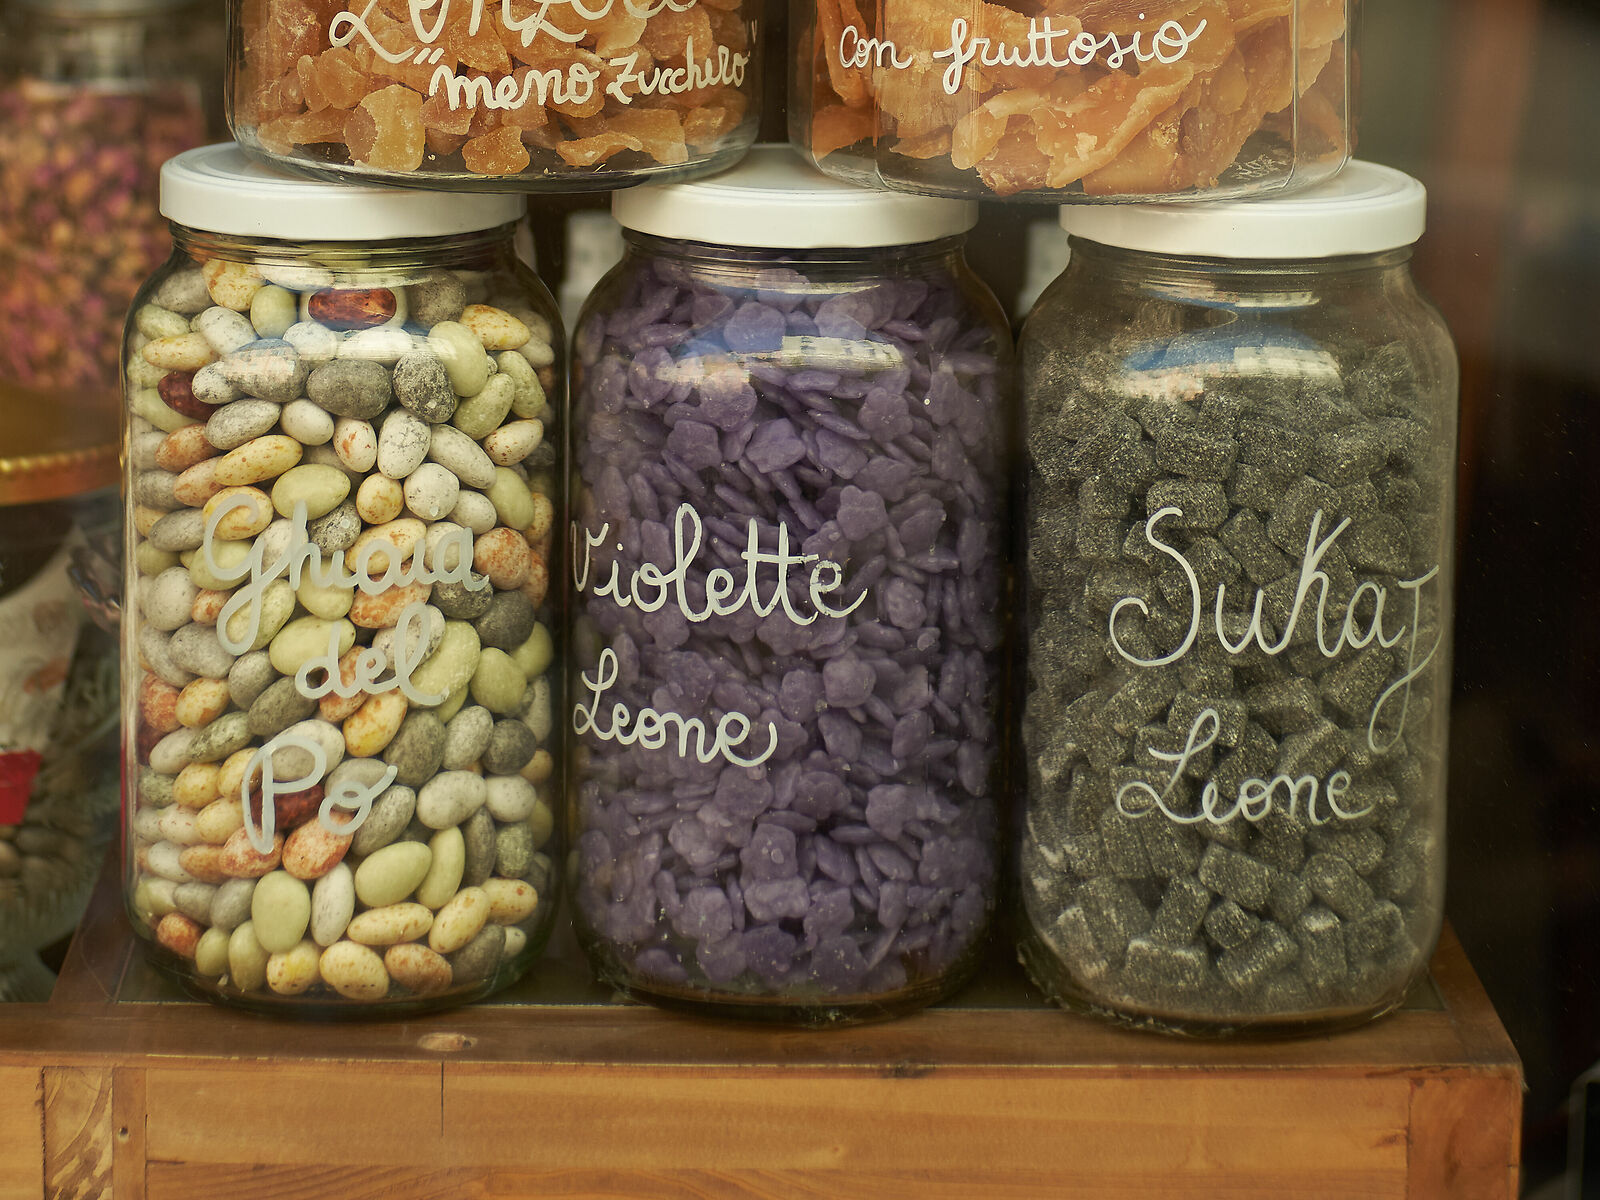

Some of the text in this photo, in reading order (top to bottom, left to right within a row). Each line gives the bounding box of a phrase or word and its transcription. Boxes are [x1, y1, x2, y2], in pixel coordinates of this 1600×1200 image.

[933, 12, 1207, 95] fruttosio
[203, 494, 490, 656] Ghiaia
[571, 503, 868, 626] Violette
[295, 601, 450, 706] del
[573, 647, 779, 768] Leone
[241, 735, 398, 855] Po
[1116, 708, 1375, 825] Leone
